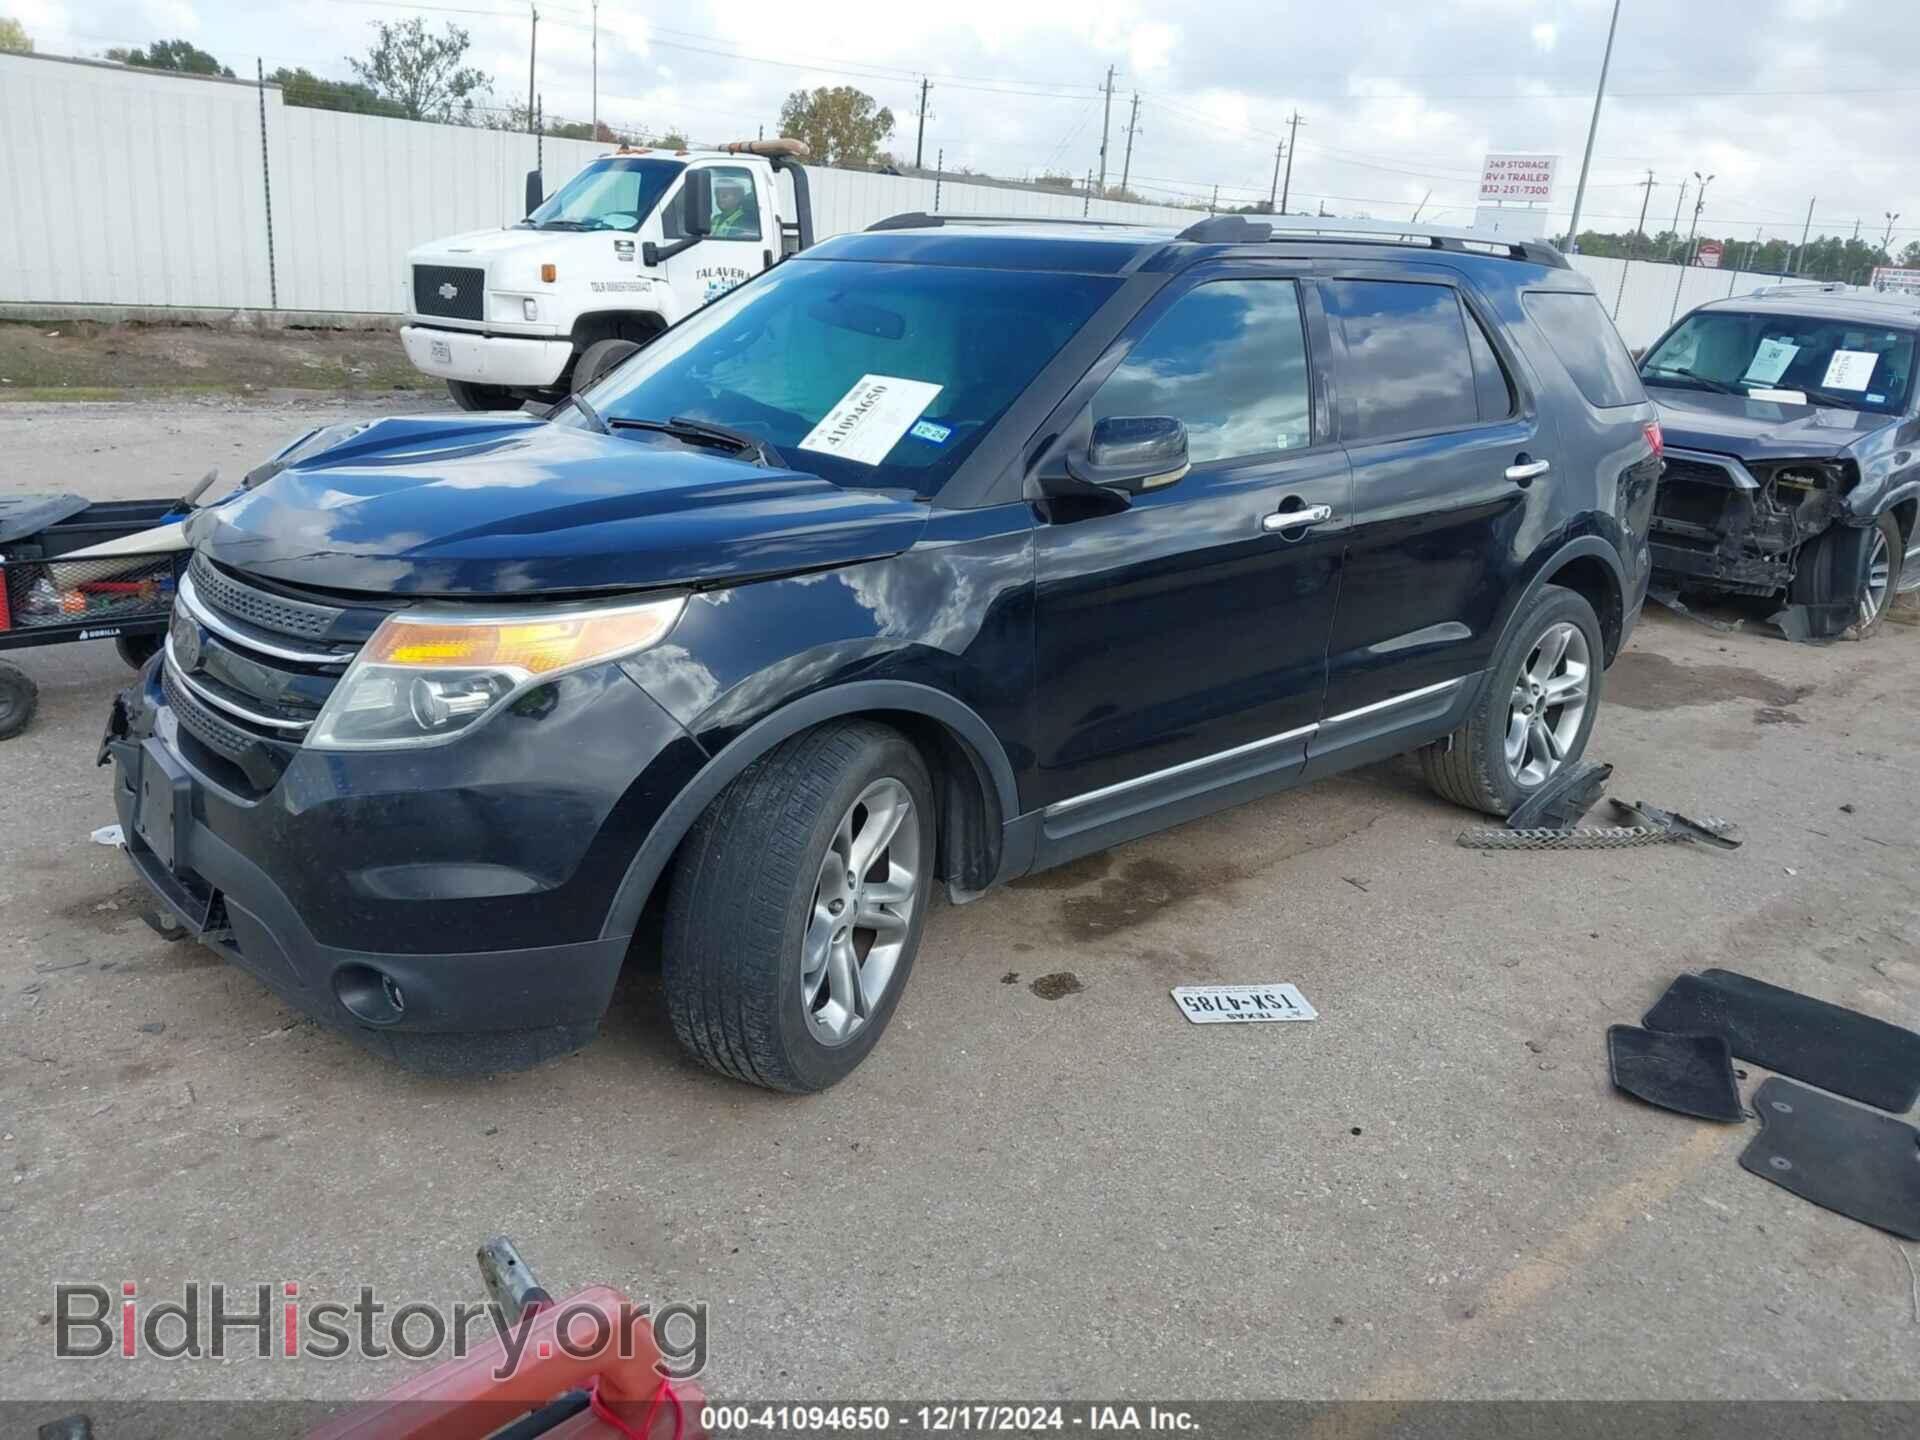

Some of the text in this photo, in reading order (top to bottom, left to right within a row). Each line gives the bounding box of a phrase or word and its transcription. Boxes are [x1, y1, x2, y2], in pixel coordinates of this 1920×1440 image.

[1489, 160, 1550, 169] 249 STORAGE
[1485, 172, 1499, 180] RV
[1507, 173, 1550, 182] TRAILER
[1481, 184, 1549, 194] 832-251-7300
[826, 385, 888, 446] 41094650
[89, 628, 121, 637] GORILLA
[1183, 993, 1298, 1012] TSX-4785
[1226, 1012, 1273, 1020] TEXAS
